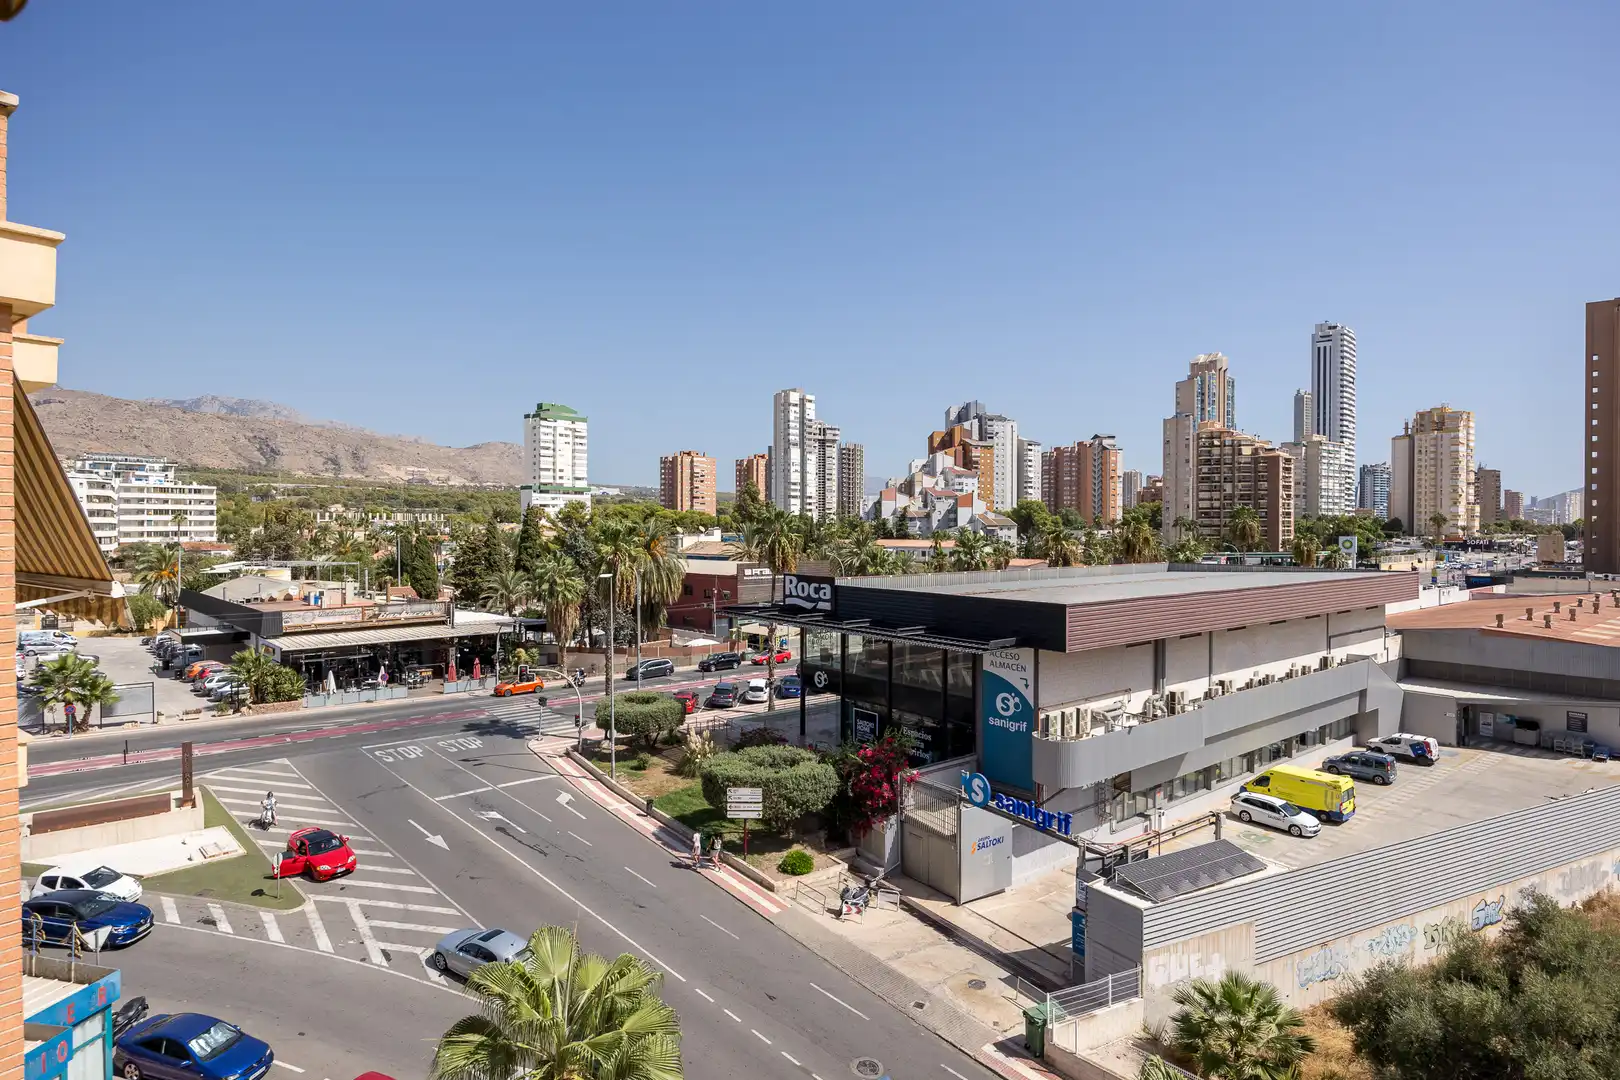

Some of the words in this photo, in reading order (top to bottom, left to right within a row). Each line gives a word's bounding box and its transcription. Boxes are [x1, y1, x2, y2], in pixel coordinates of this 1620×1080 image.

[785, 575, 831, 600] Roca
[989, 651, 1020, 661] ACCESO
[989, 660, 1027, 673] ALMACÉN
[988, 716, 1028, 733] sanigrif
[437, 736, 484, 753] STOP
[374, 745, 424, 762] STOP
[995, 793, 1073, 836] sanigrif
[977, 836, 1004, 851] SALTOKI
